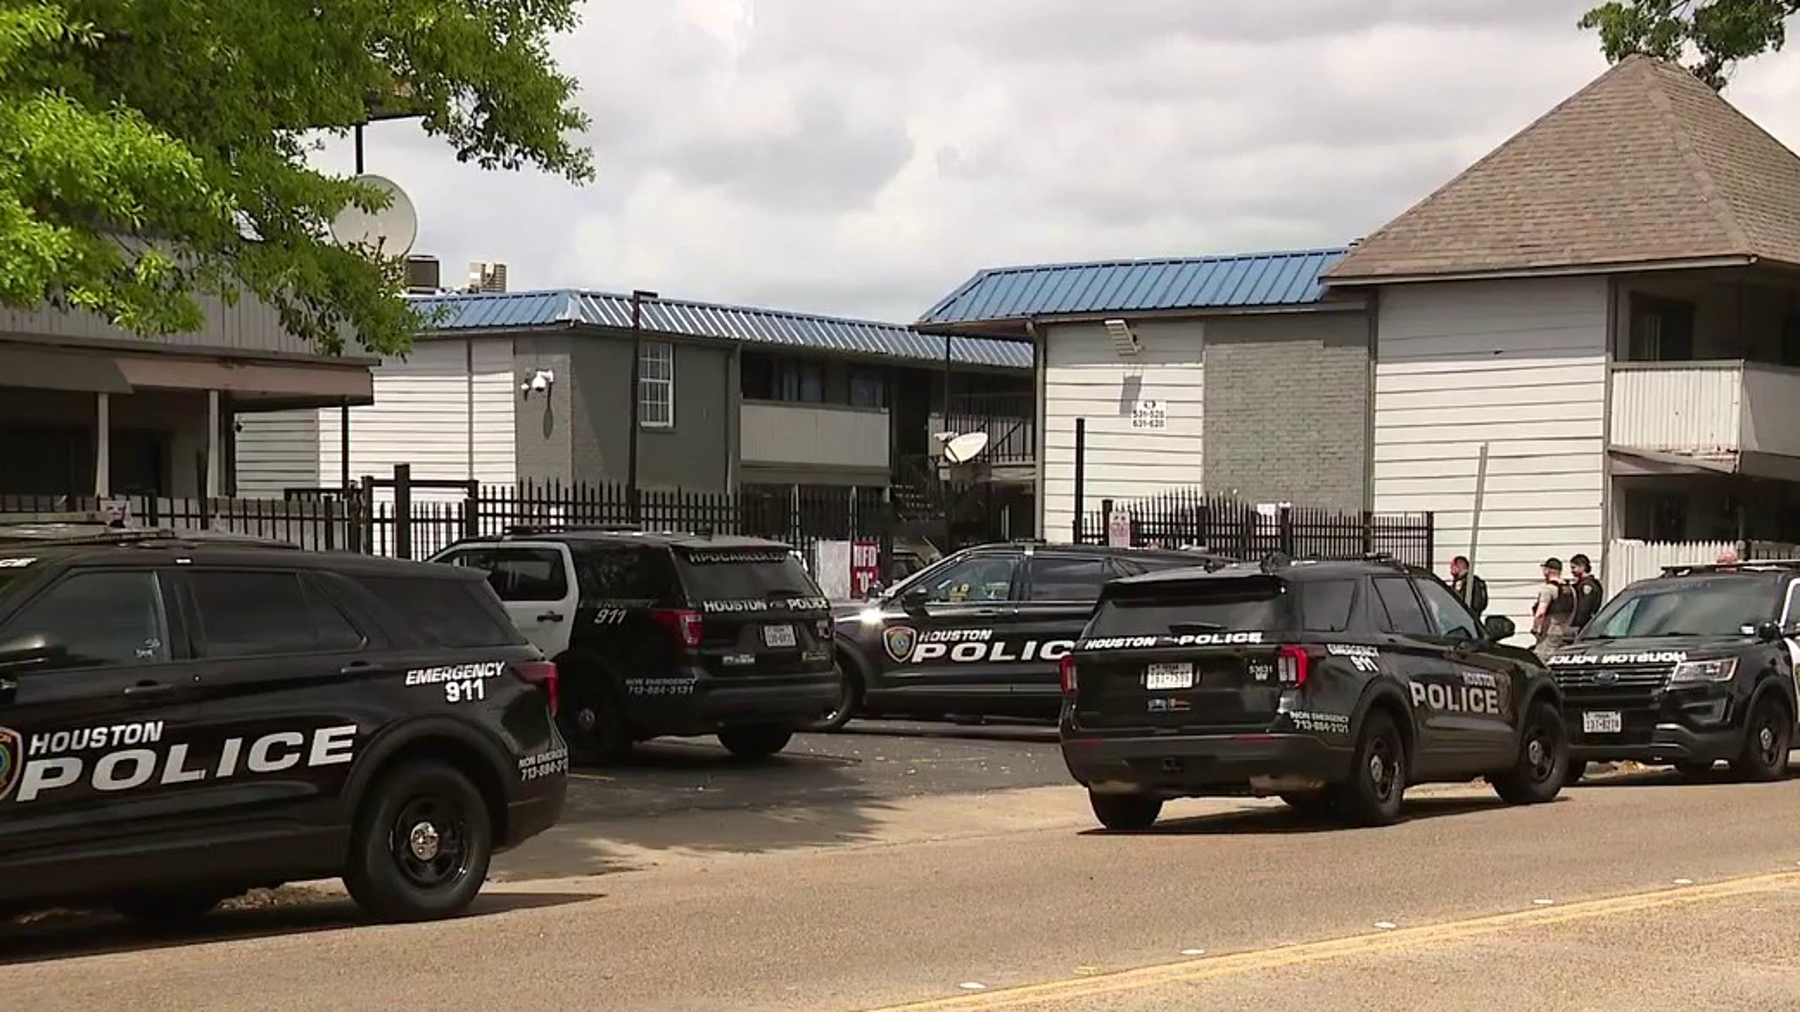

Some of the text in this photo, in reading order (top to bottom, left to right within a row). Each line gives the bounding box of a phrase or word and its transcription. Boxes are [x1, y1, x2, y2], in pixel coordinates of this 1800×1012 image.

[594, 608, 627, 625] 911
[703, 597, 829, 613] HOUSTON POLICE
[918, 629, 993, 643] HOUSTON
[1084, 632, 1263, 650] HOUSTON POLICE
[911, 640, 1076, 664] POLIC
[1350, 656, 1379, 672] 911
[405, 661, 506, 687] EMERGENCY
[445, 678, 485, 703] 911
[1409, 681, 1500, 714] POLICE
[29, 721, 164, 756] HOUSTON
[15, 724, 358, 802] POLICE
